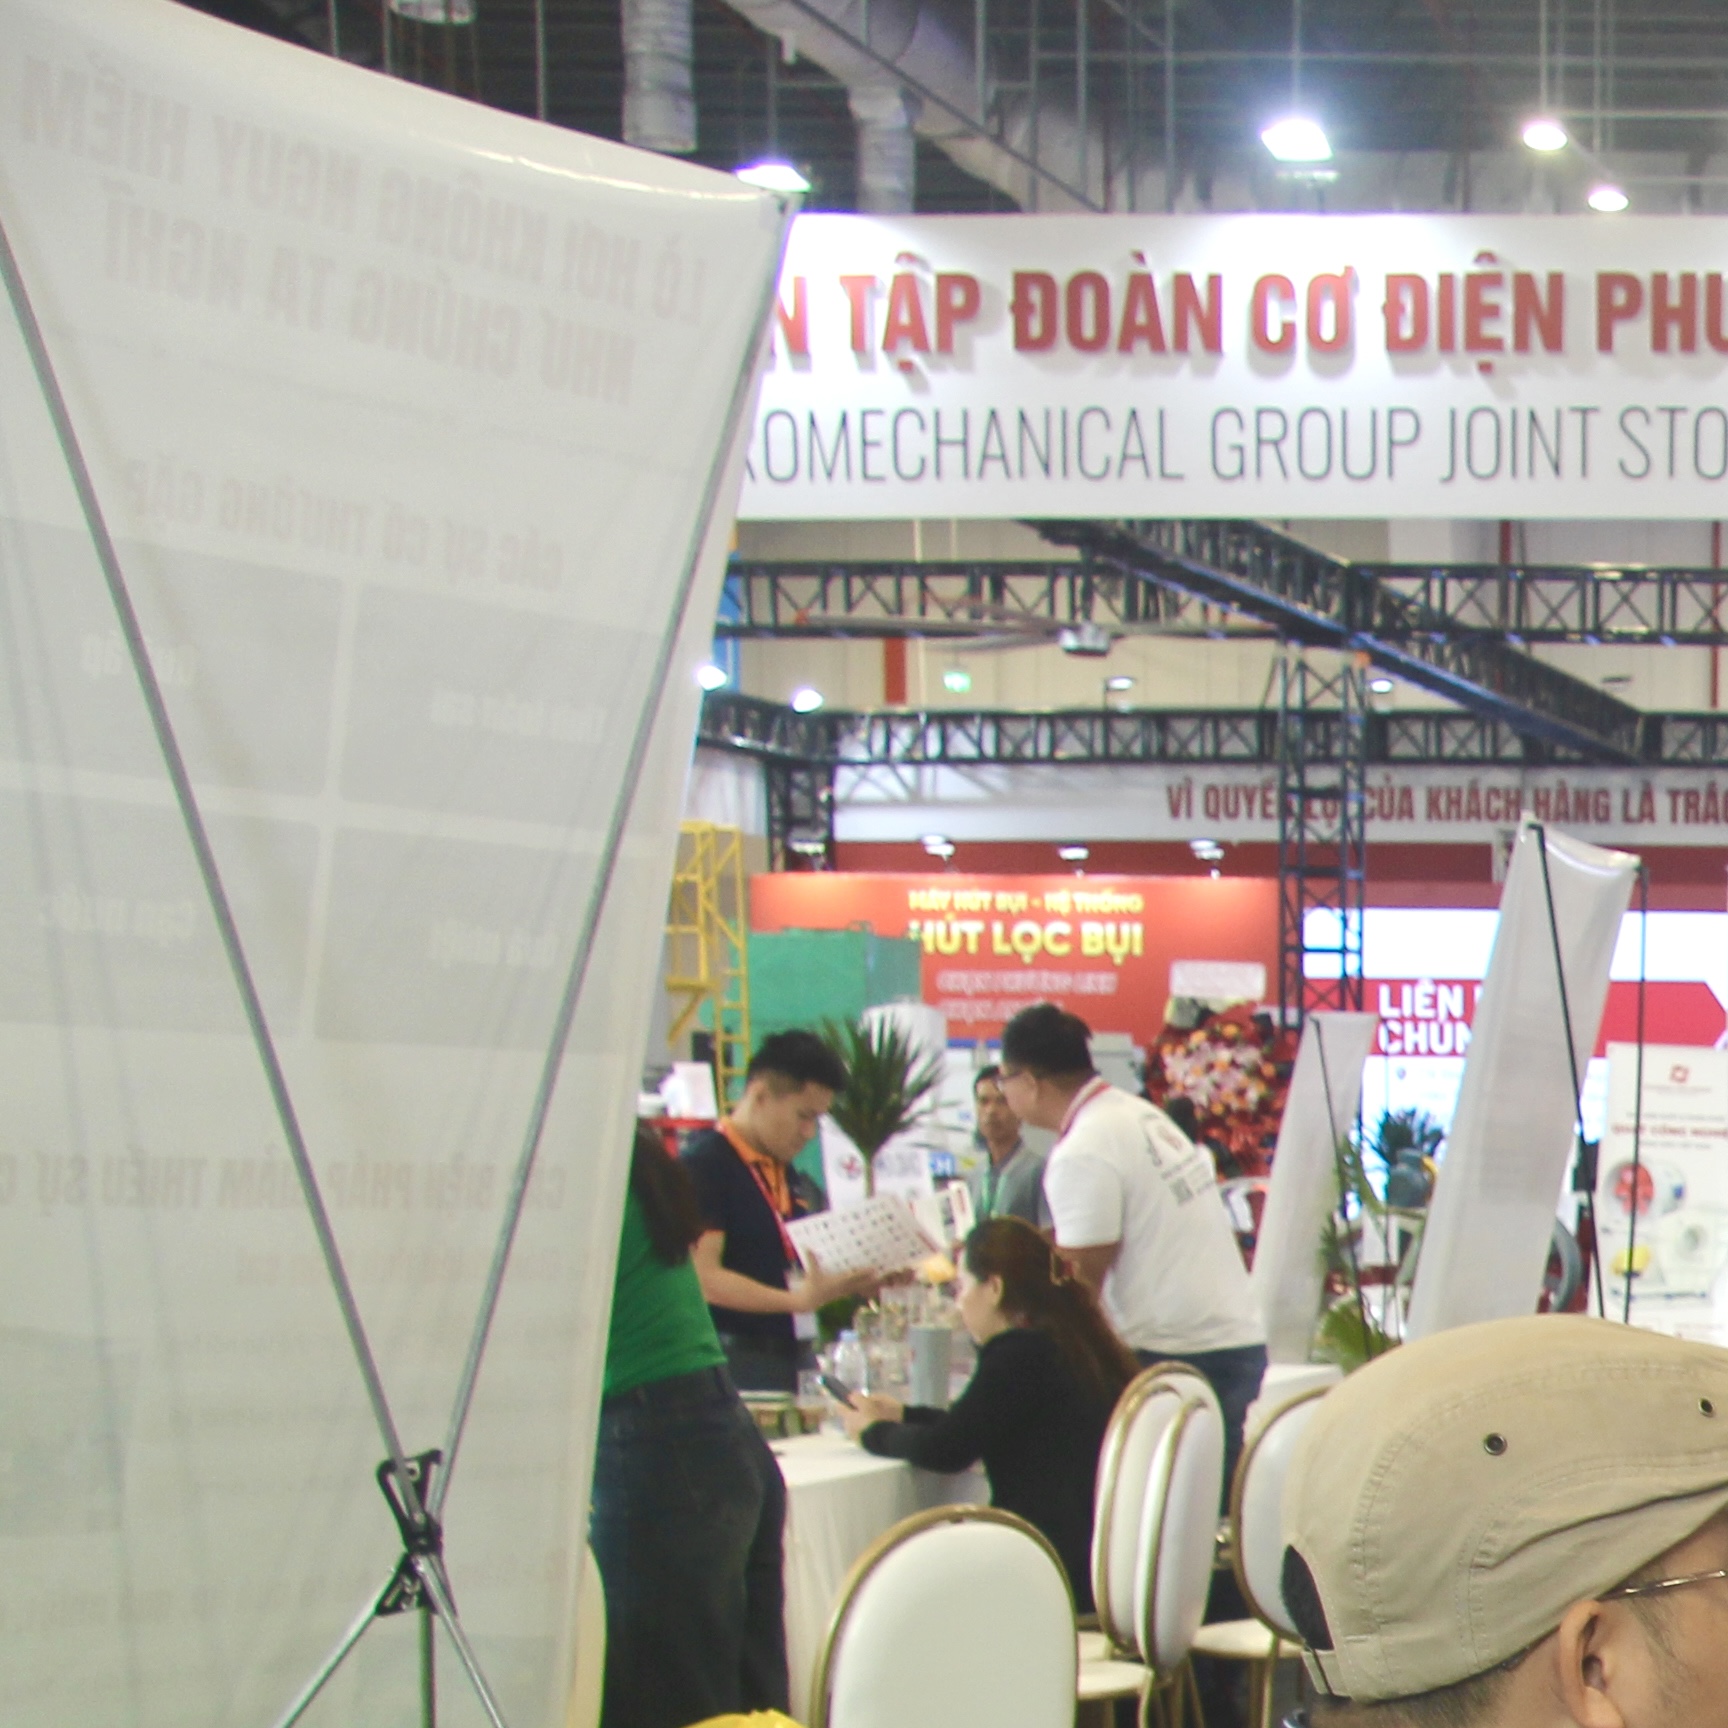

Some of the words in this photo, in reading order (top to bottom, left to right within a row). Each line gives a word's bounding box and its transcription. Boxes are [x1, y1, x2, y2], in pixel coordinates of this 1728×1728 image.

[840, 251, 981, 372] TẬP
[1010, 251, 1223, 353] ĐOÀN
[1250, 265, 1356, 353] CƠ
[1381, 251, 1564, 373] ĐIỆN
[1211, 407, 1419, 482] GROUP
[1440, 407, 1600, 485] JOINT
[1166, 775, 1195, 820] VÌ
[1426, 780, 1523, 823] KHÁCH
[1532, 782, 1611, 824] HÀNG
[1621, 782, 1658, 824] LÀ
[992, 920, 1072, 965] LỌC
[1081, 922, 1143, 966] BỤI
